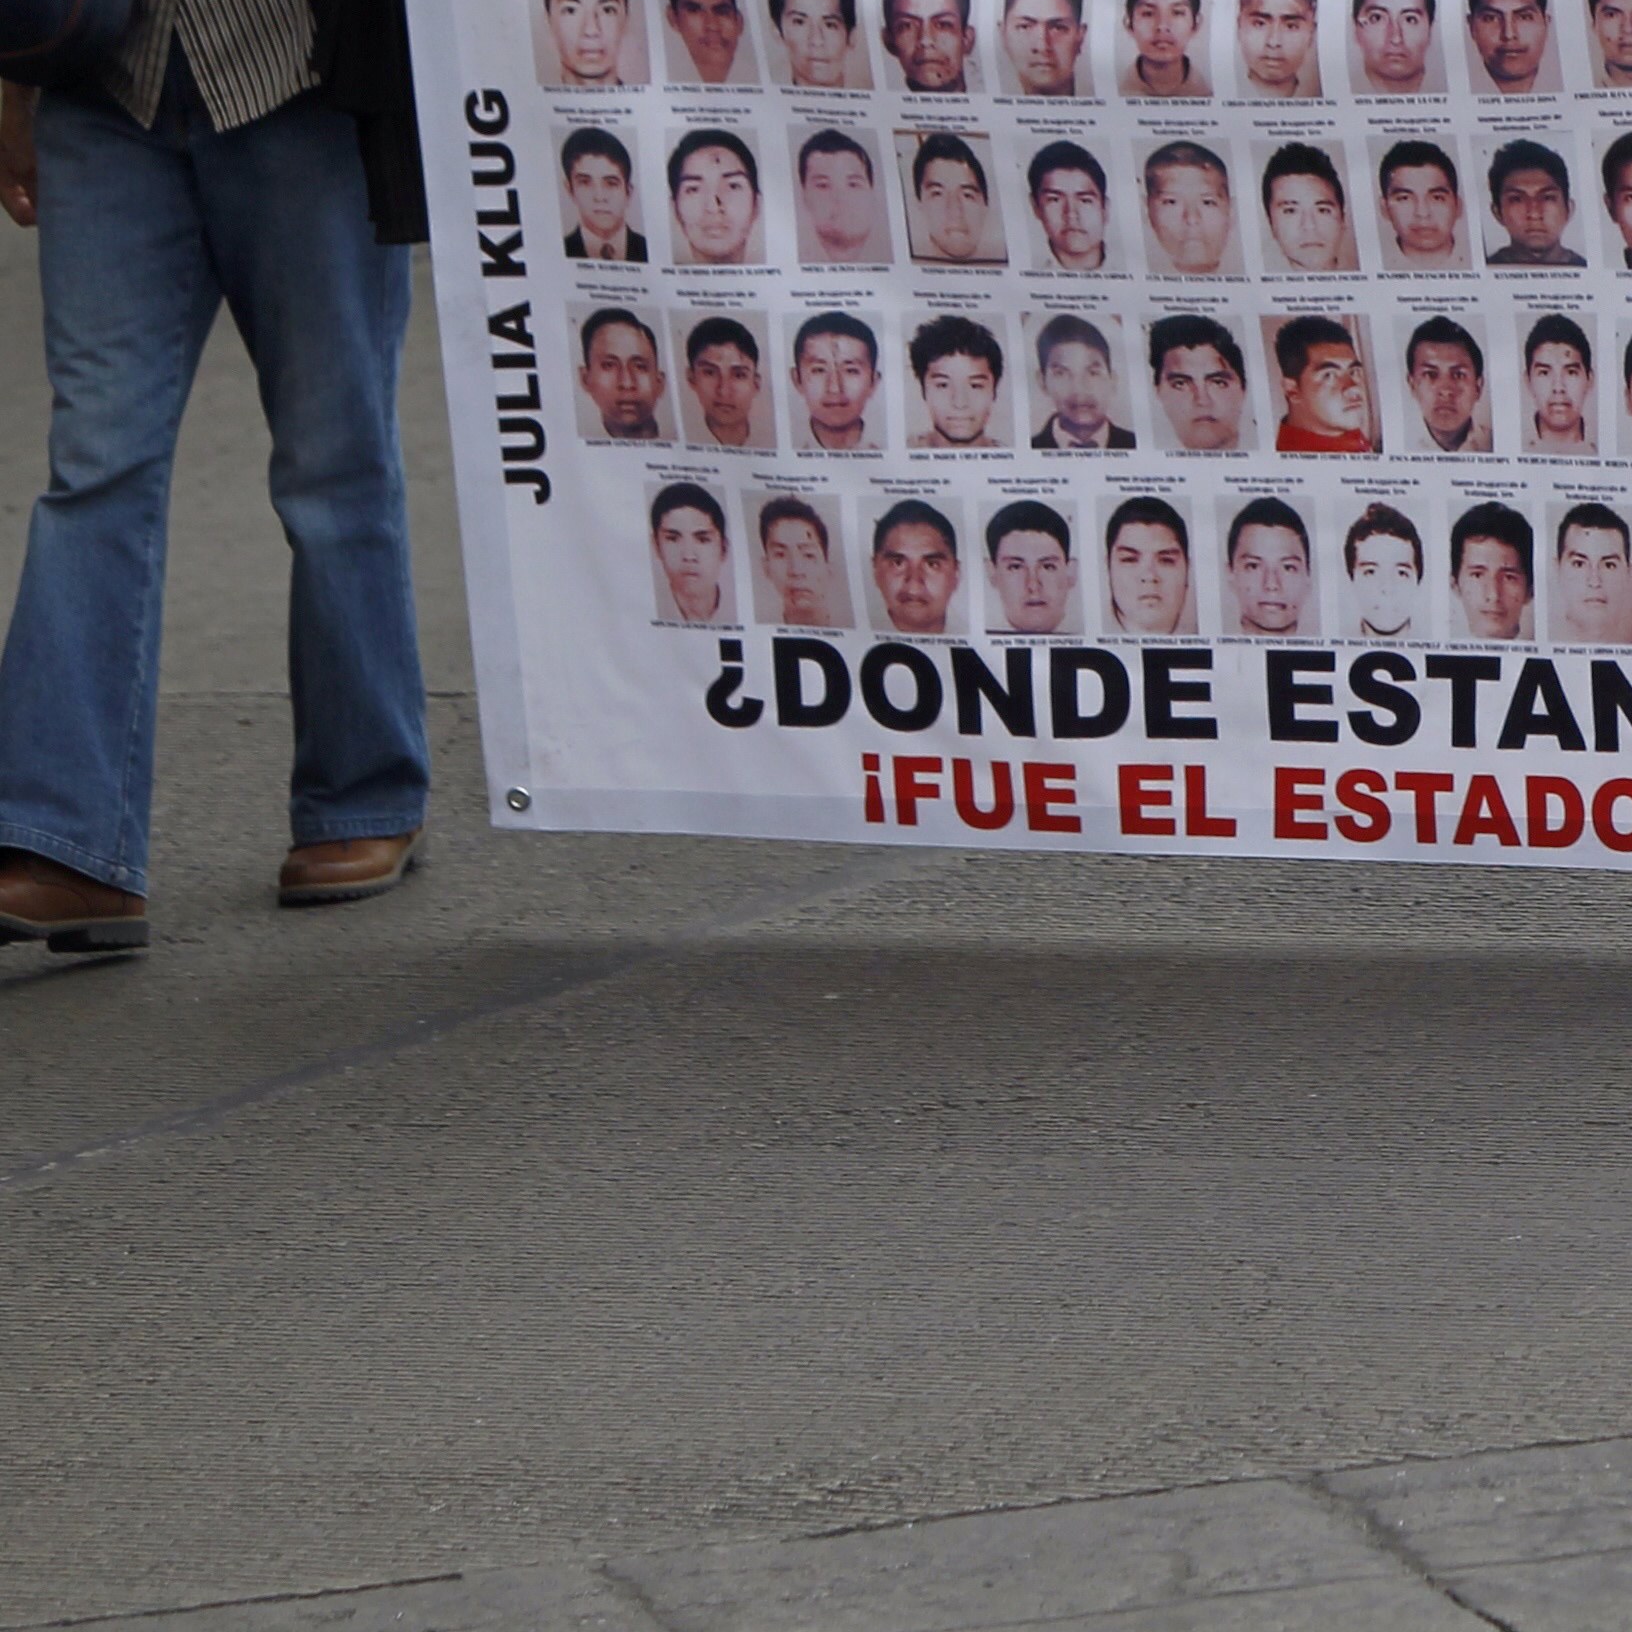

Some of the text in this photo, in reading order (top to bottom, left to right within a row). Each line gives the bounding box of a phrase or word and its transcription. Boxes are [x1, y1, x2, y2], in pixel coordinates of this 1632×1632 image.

[464, 87, 552, 507] JULIA KLUG
[705, 637, 1219, 740] ¿DONDE
[862, 753, 1081, 833] ¡FUE
[1117, 764, 1237, 838] EL
